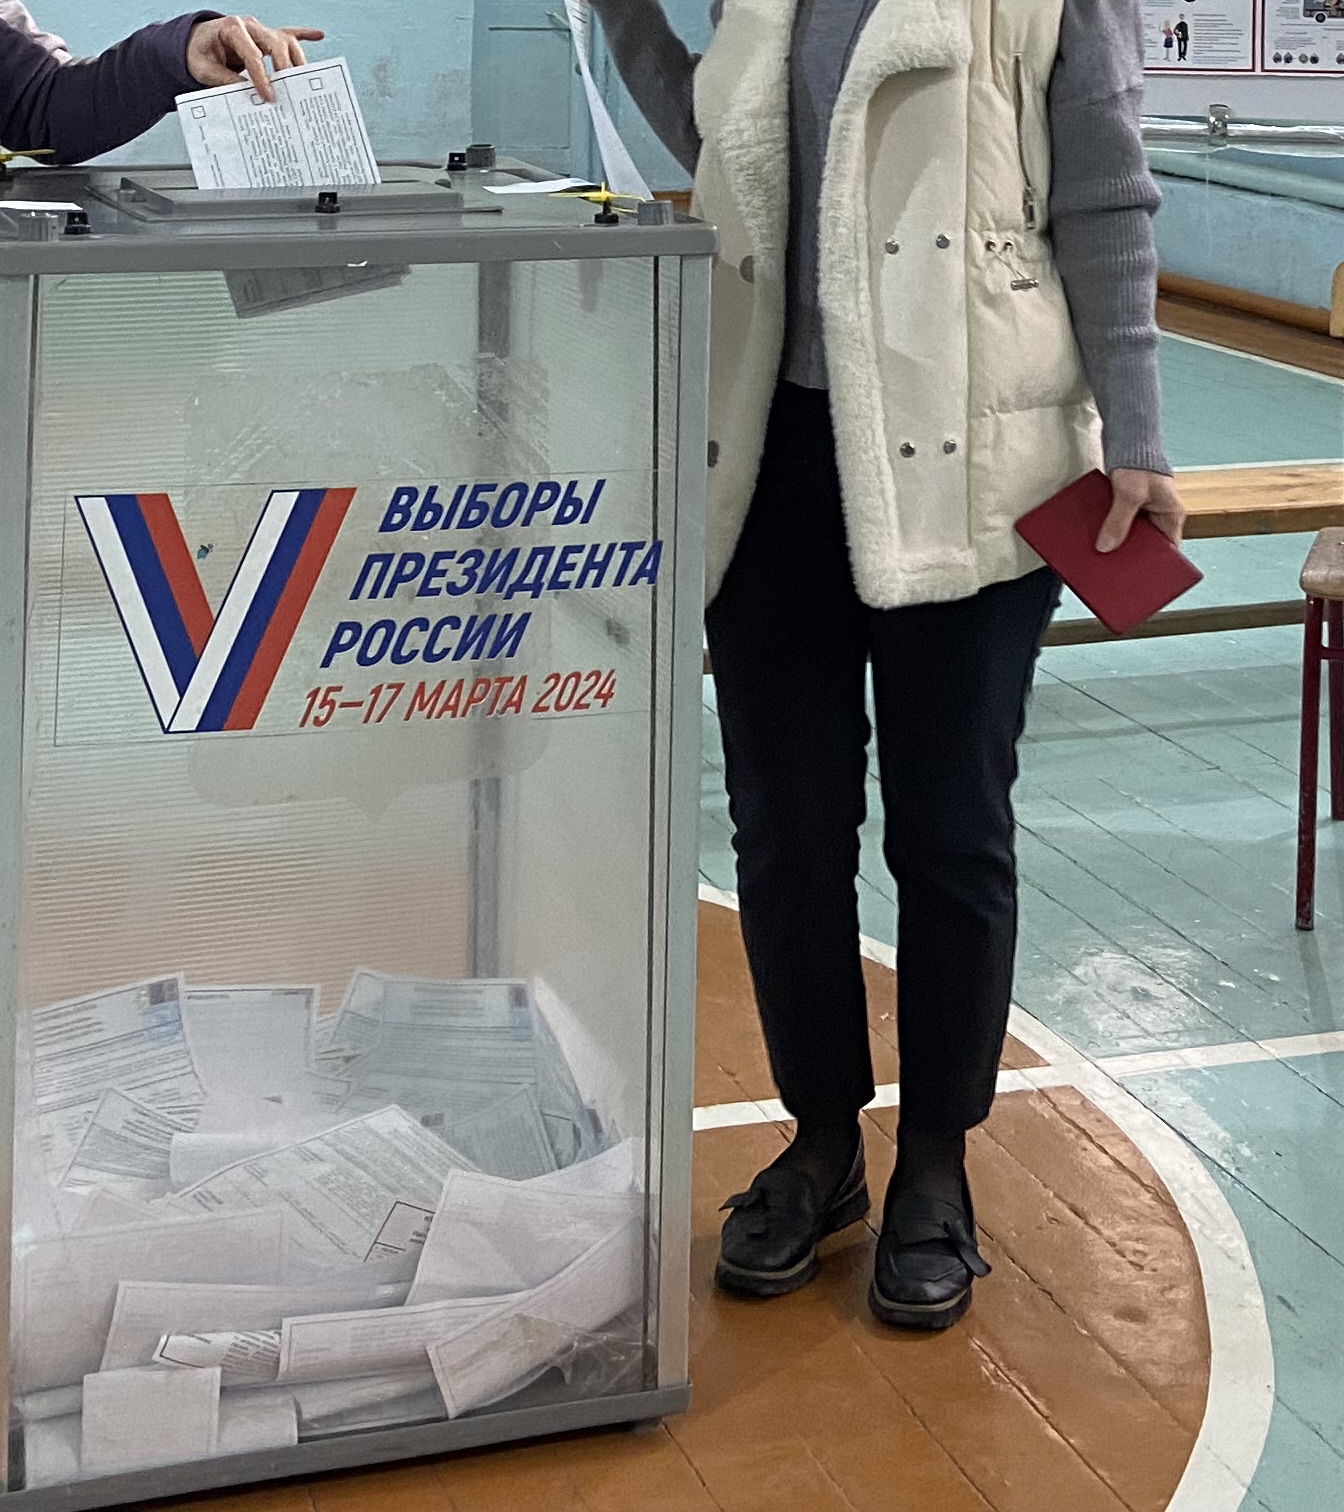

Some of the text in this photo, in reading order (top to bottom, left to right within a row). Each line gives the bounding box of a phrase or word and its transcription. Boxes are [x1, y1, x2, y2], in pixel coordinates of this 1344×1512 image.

[378, 478, 606, 533] ВЫБОРЫ
[348, 539, 664, 601] ПРЕЗИДЕНТА
[319, 611, 532, 669] РОССИИ
[403, 674, 528, 722] МАРТА
[531, 668, 617, 714] 2024
